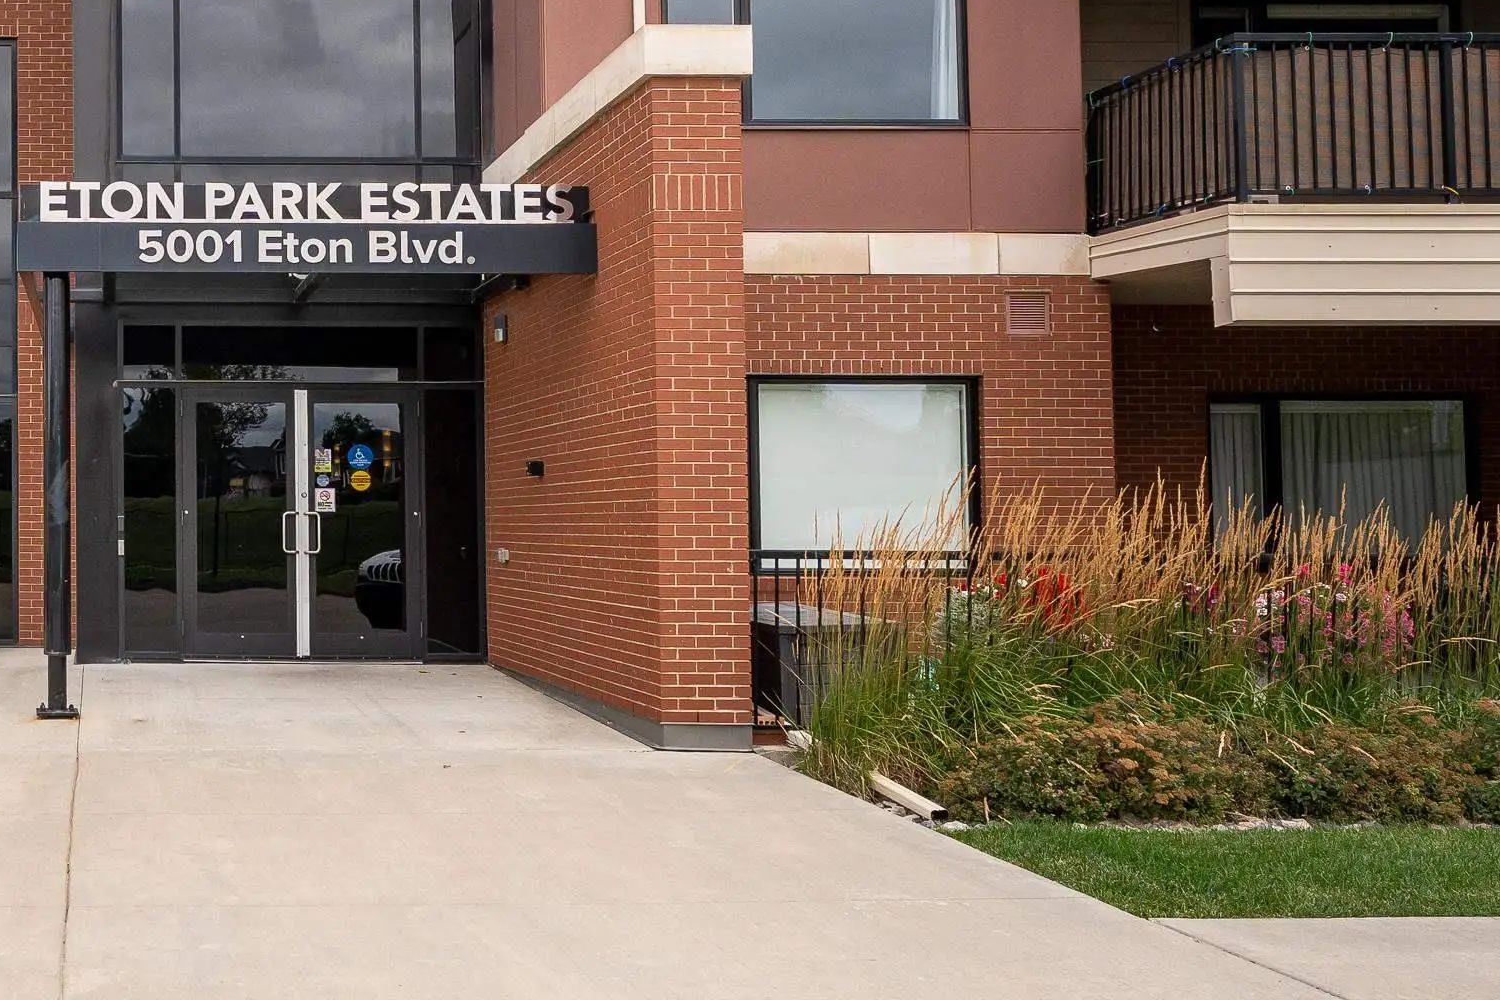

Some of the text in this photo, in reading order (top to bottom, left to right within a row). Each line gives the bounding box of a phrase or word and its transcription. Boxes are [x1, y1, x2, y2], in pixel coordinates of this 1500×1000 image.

[40, 181, 575, 222] ETON PARK ESTATES
[138, 229, 476, 265] 5001 Eton Blvd.
